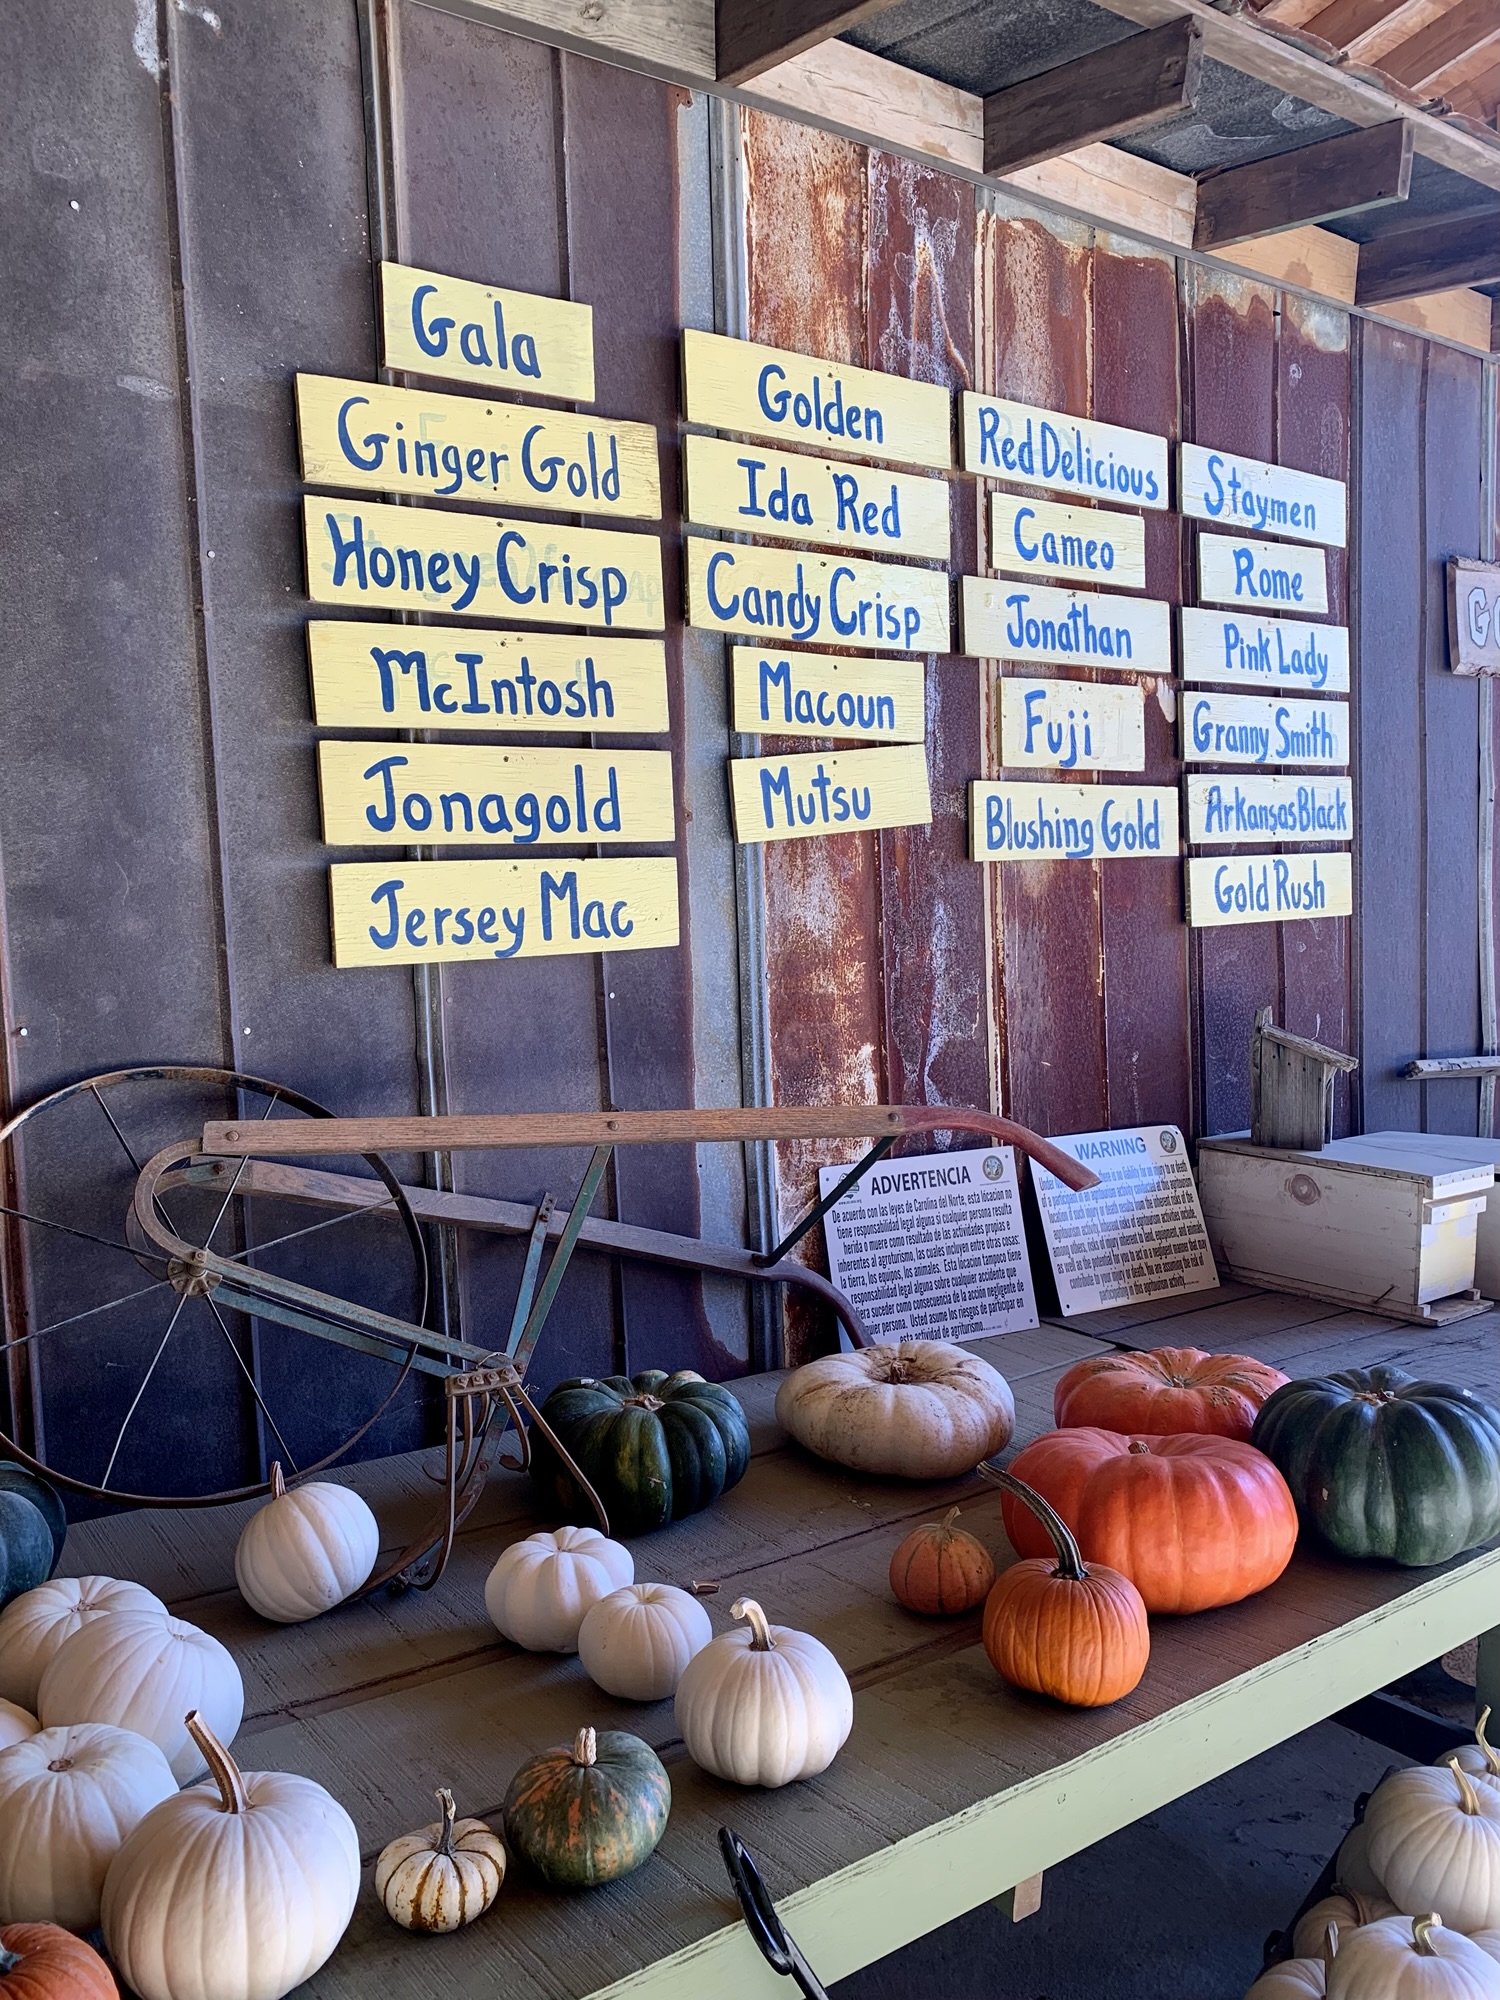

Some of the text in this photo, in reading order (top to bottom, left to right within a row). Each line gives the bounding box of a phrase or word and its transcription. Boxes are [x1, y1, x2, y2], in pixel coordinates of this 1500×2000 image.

[412, 285, 542, 379] Gala
[758, 364, 884, 444] Golden
[338, 397, 620, 502] Ginger Gold
[737, 458, 902, 538] Ida Red
[1204, 455, 1316, 530] Staymen
[326, 513, 627, 625] Honey Crisp
[1014, 507, 1115, 571] Cameo
[707, 552, 921, 649] Candy Crisp
[1233, 548, 1304, 602] Rome
[1006, 594, 1133, 660] Jonathan
[1223, 623, 1328, 688] Pink Lady
[370, 647, 615, 718] McIntosh
[759, 661, 895, 730] Macoun
[1024, 689, 1092, 768] Fuji
[1193, 700, 1333, 763] Granny Smith
[364, 756, 621, 844] Jonagold
[760, 764, 871, 828] Mutsu
[986, 794, 1161, 859] Blushing Gold
[369, 871, 633, 957] Jersey Mac
[1214, 859, 1325, 914] Gold Rush
[872, 1166, 971, 1195] ADVERTENCIA
[1075, 1137, 1146, 1160] WARNING
